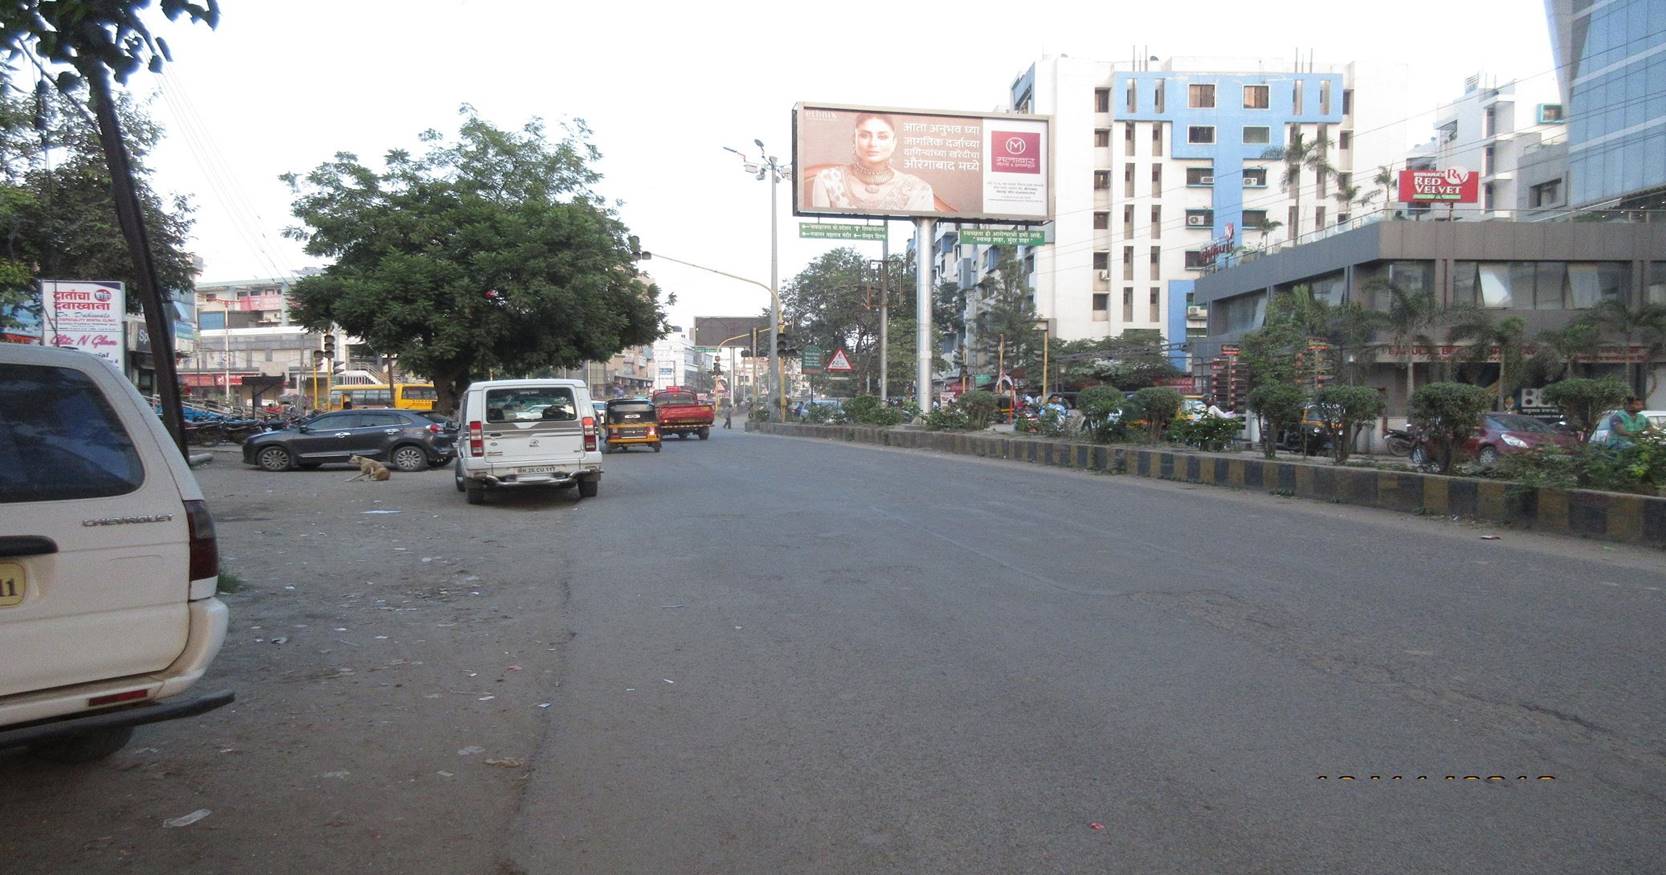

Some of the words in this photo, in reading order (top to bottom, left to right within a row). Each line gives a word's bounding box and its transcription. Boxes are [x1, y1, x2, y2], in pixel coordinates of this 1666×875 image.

[1414, 176, 1441, 186] RED
[1414, 185, 1462, 194] VELVET
[54, 302, 111, 310] दवाखाना
